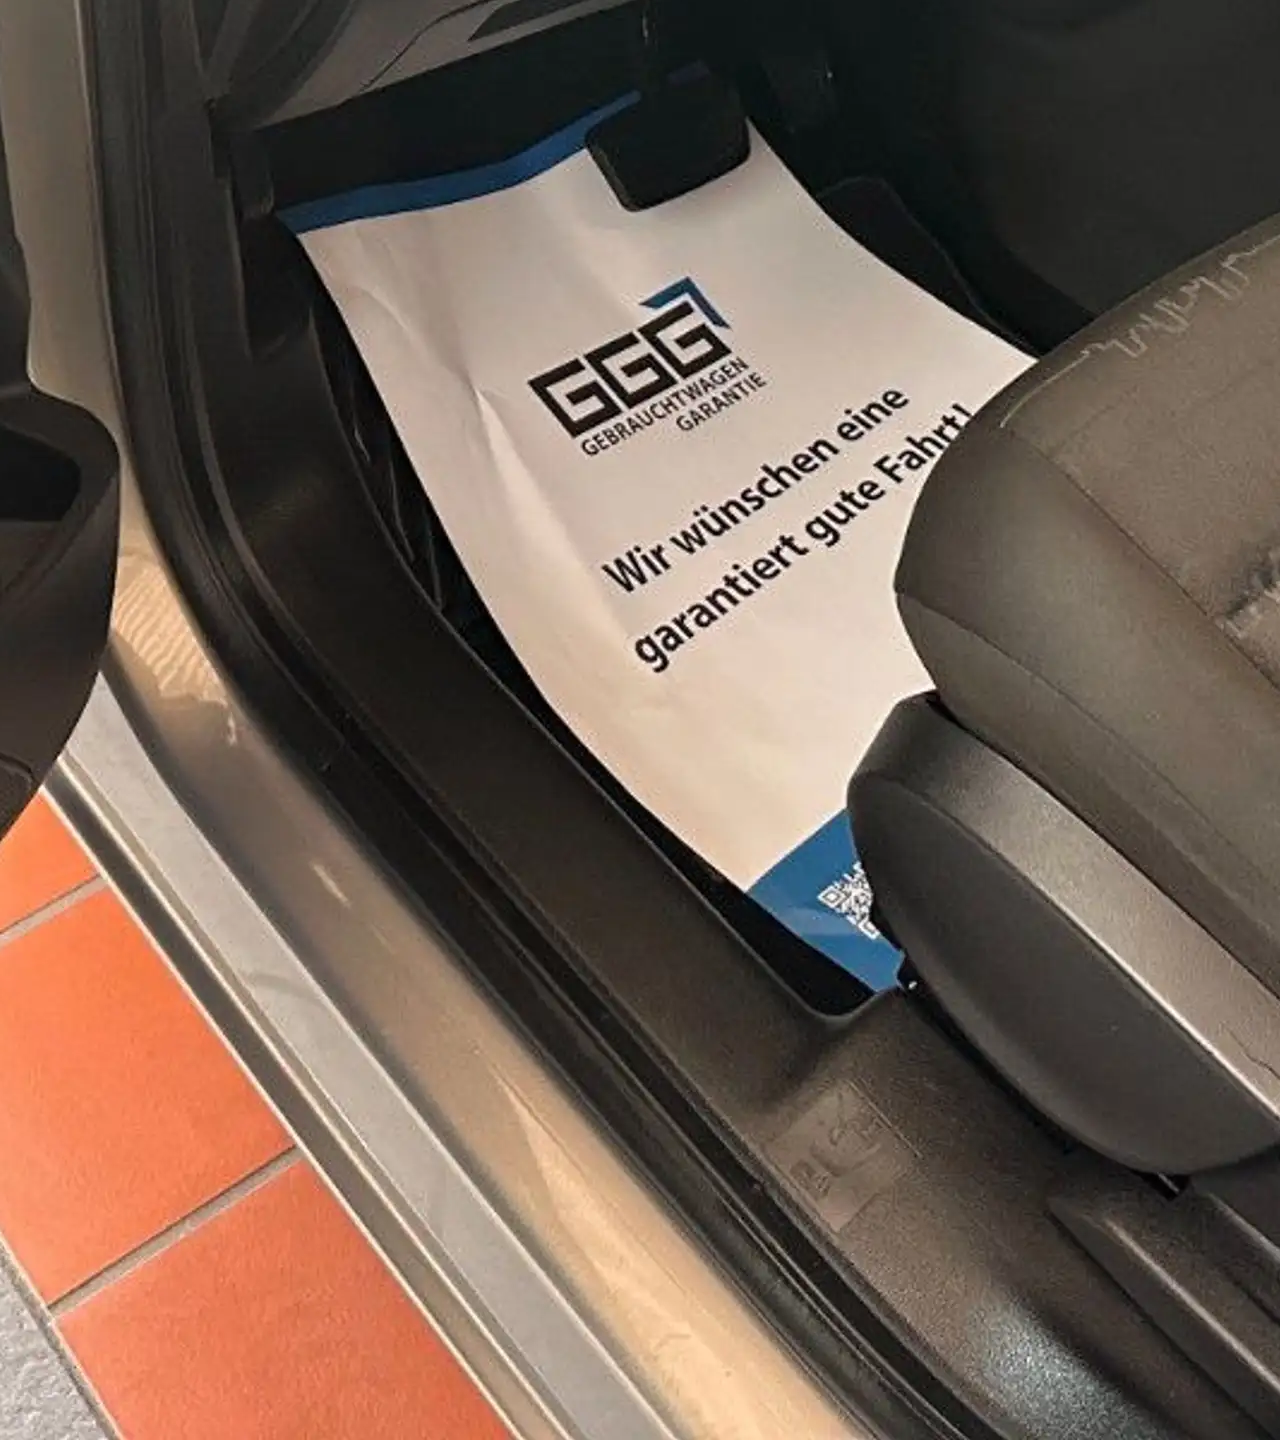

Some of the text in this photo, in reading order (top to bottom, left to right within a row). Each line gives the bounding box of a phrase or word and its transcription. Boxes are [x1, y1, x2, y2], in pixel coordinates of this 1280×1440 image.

[528, 301, 731, 438] GGG
[581, 357, 749, 456] GEBRAUCHTWAGEN
[676, 373, 765, 431] GARANTIE
[602, 391, 908, 592] Wir wünschen eine
[636, 536, 809, 673] garantiert
[806, 481, 885, 547] gute
